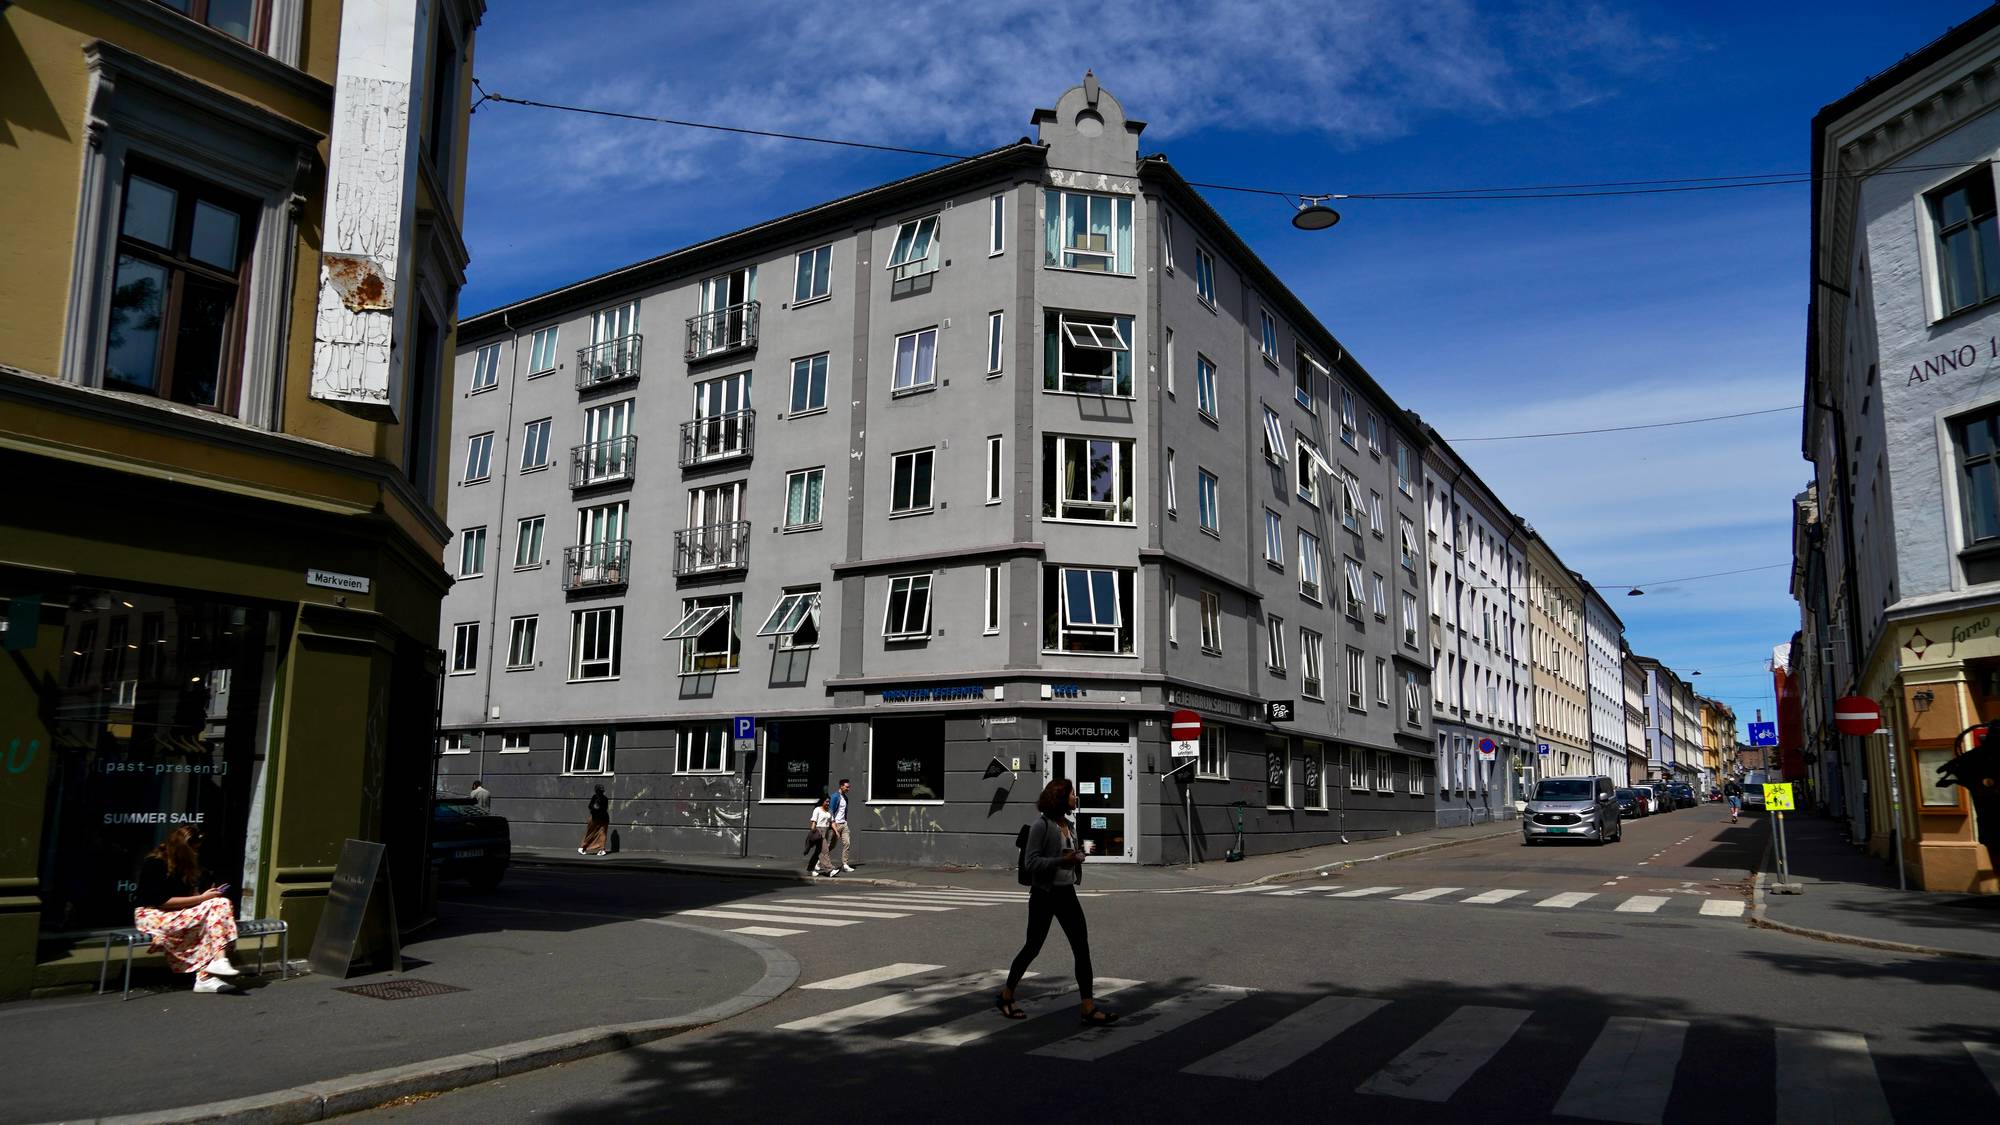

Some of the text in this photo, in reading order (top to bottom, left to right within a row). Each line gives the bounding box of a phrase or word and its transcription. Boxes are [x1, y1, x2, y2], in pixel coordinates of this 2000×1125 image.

[1906, 344, 1976, 387] ANNO
[315, 573, 362, 588] Markveien
[1947, 617, 1991, 658] forno
[740, 720, 750, 736] P
[1055, 727, 1120, 737] BRUKTBUTIKK
[98, 758, 227, 775] [past-present]
[103, 813, 205, 824] SUMMER SALE
